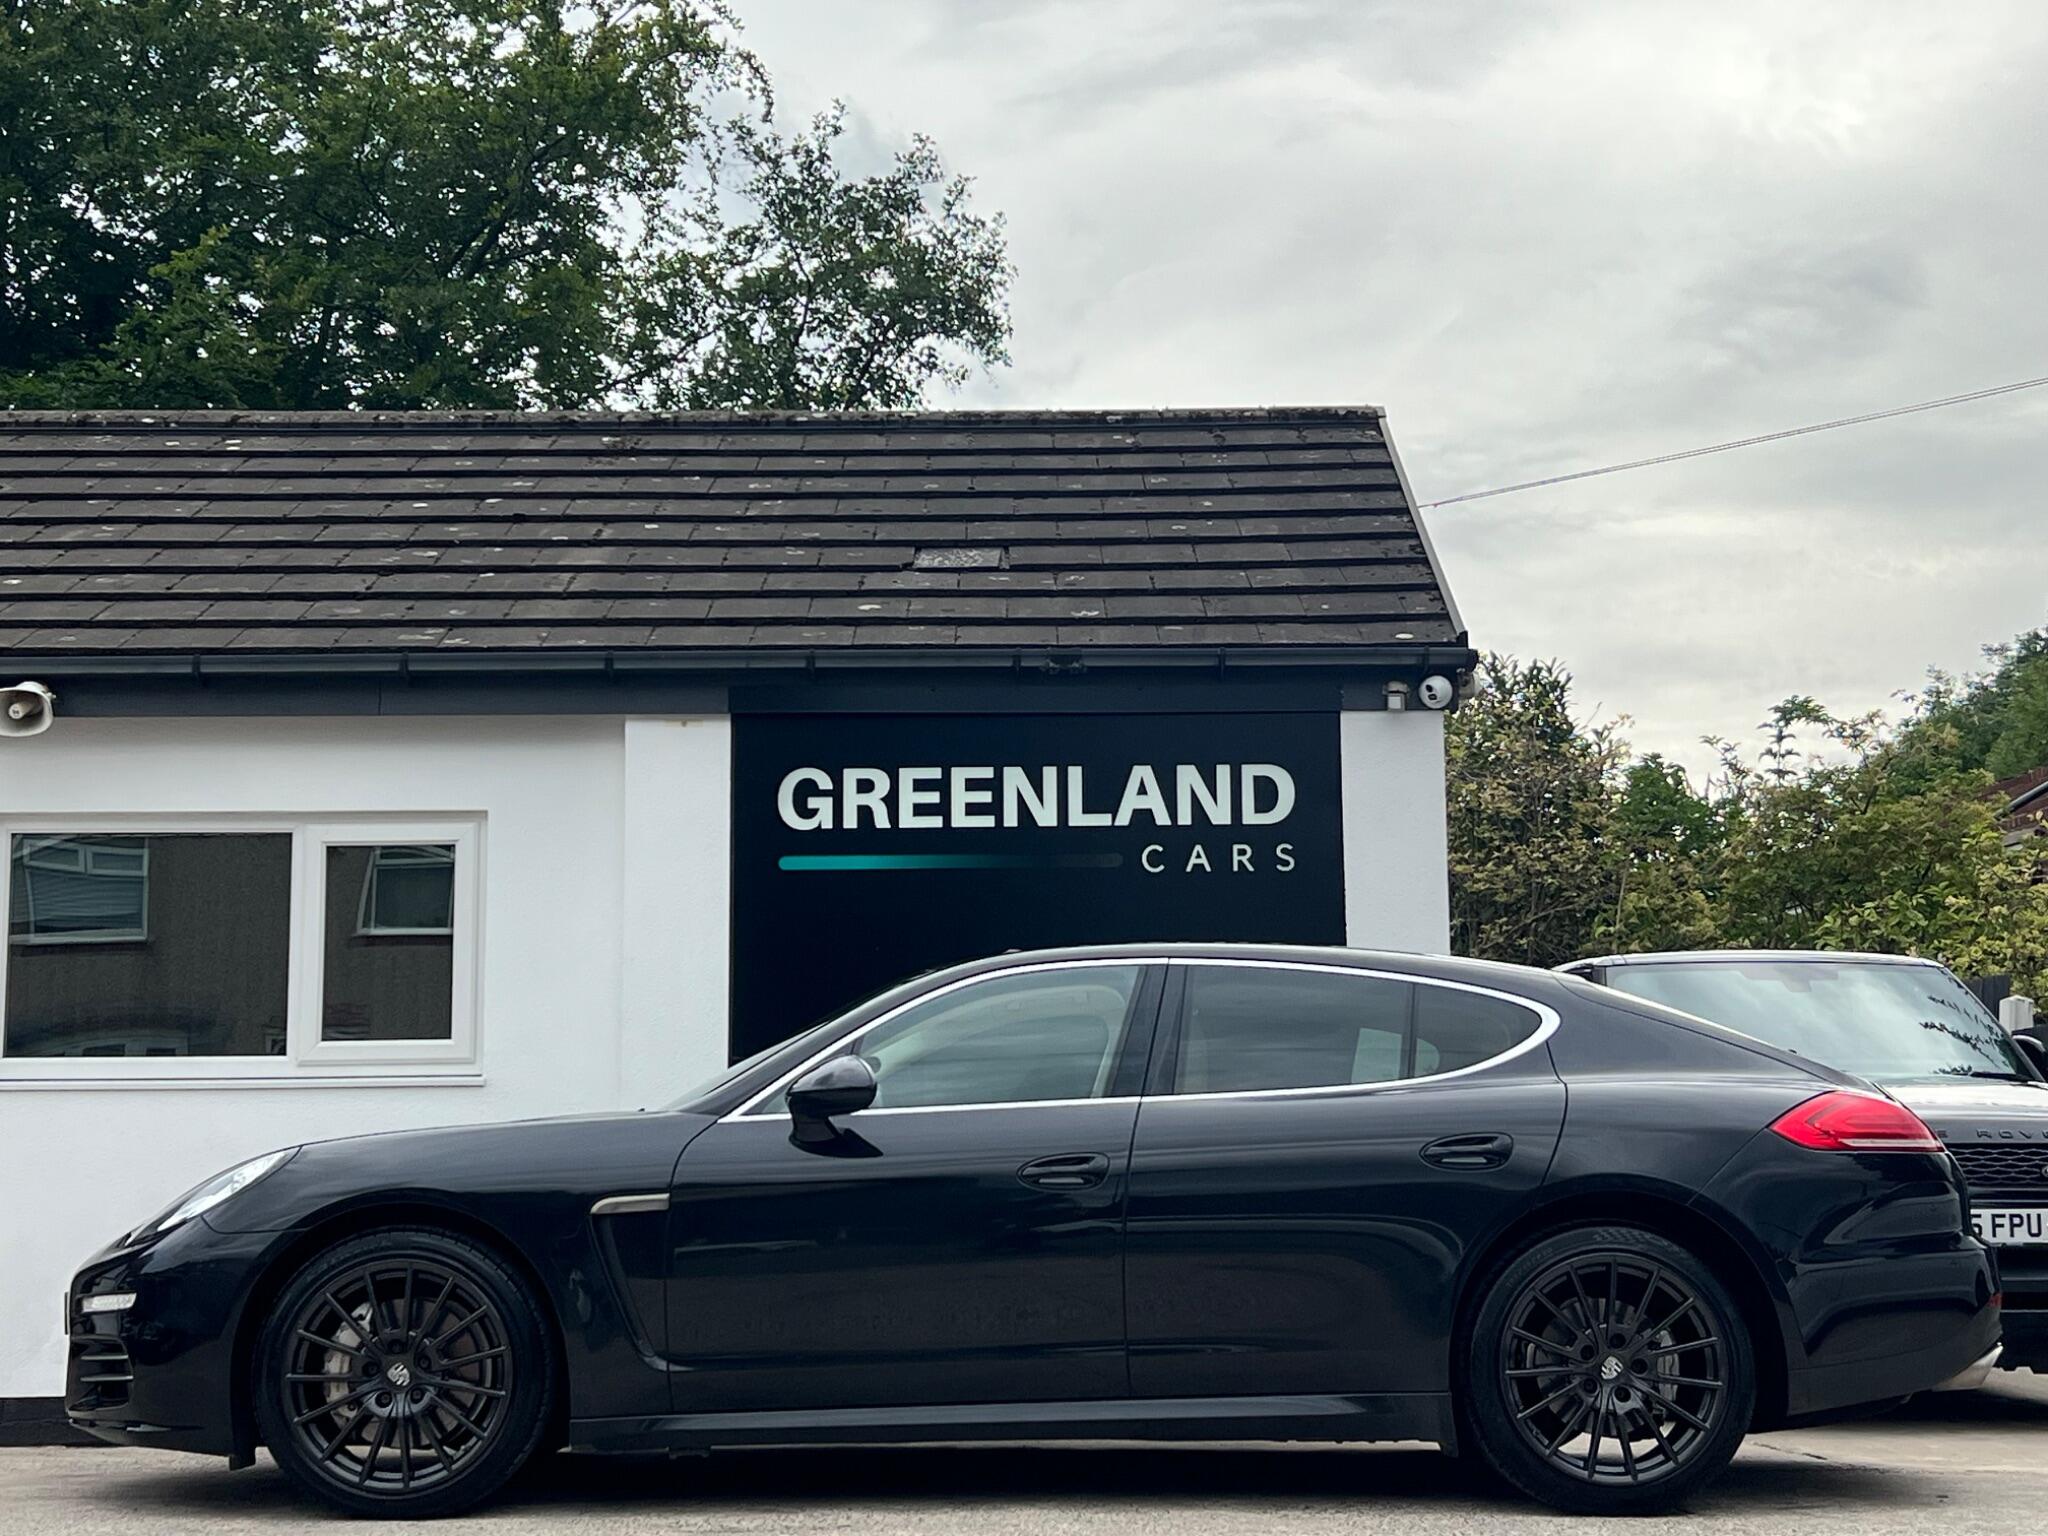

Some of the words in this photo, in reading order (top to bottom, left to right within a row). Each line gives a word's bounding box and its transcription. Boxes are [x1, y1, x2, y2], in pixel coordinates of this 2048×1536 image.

[777, 763, 1296, 831] GREENLAND
[1141, 843, 1296, 873] CARS
[1990, 1213, 2043, 1238] FPU
